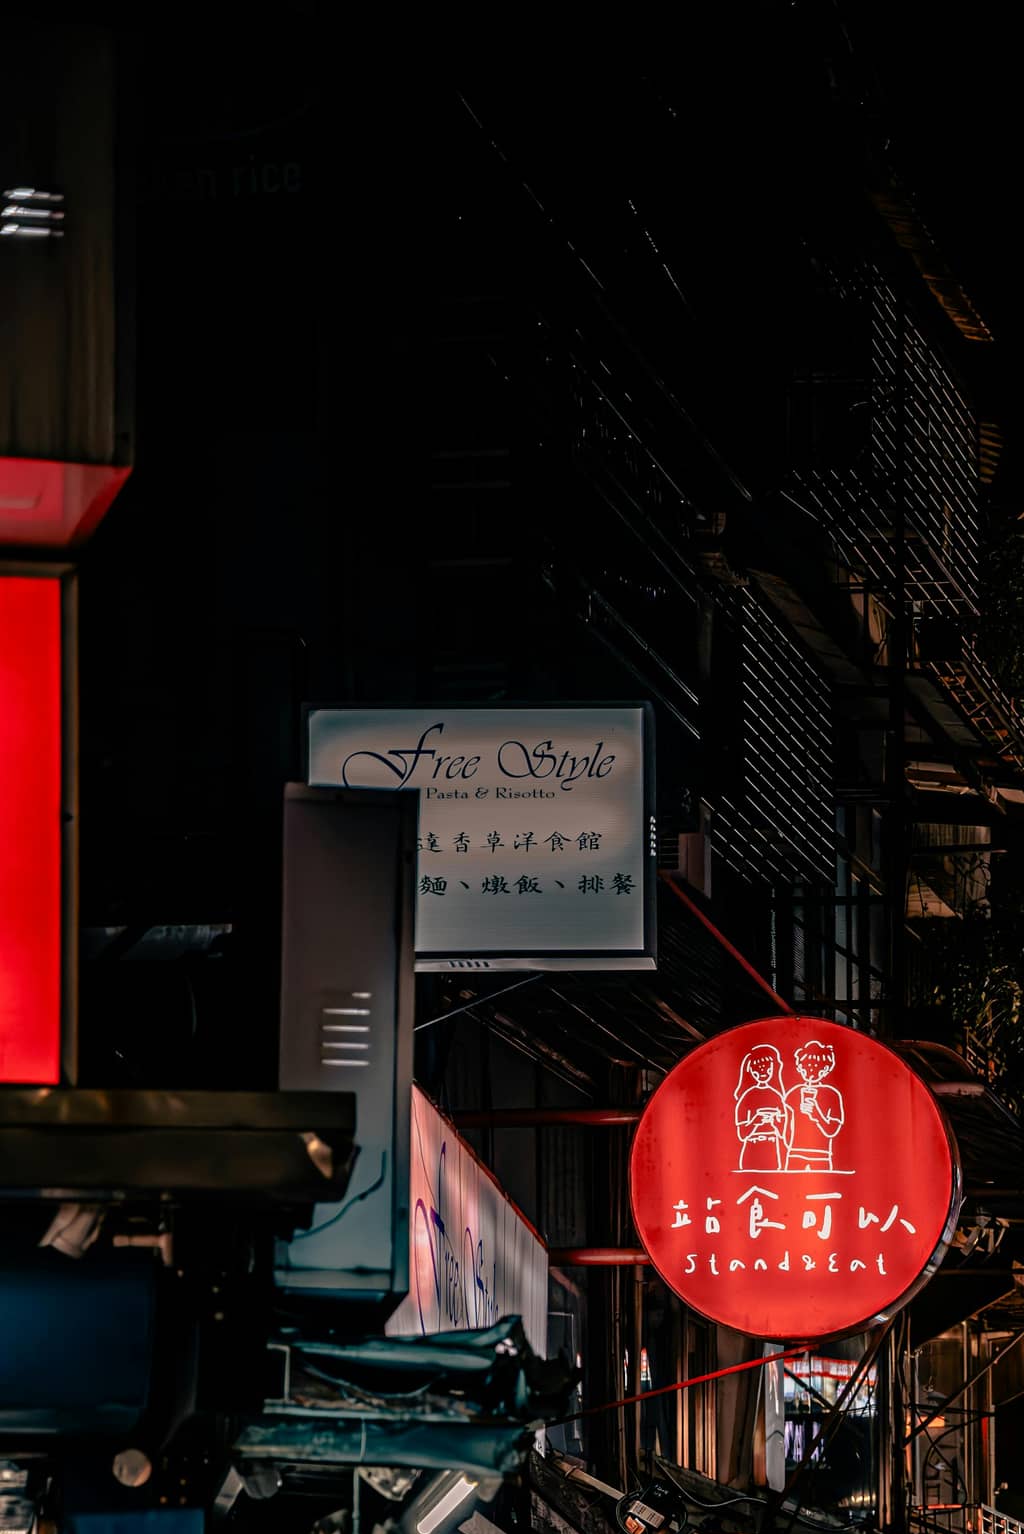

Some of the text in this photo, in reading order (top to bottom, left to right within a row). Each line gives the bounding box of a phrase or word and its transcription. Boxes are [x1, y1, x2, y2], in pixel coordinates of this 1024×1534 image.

[341, 722, 616, 791] Free Style
[426, 787, 556, 800] Pasta & Risotto
[671, 1185, 916, 1239] 站食可以
